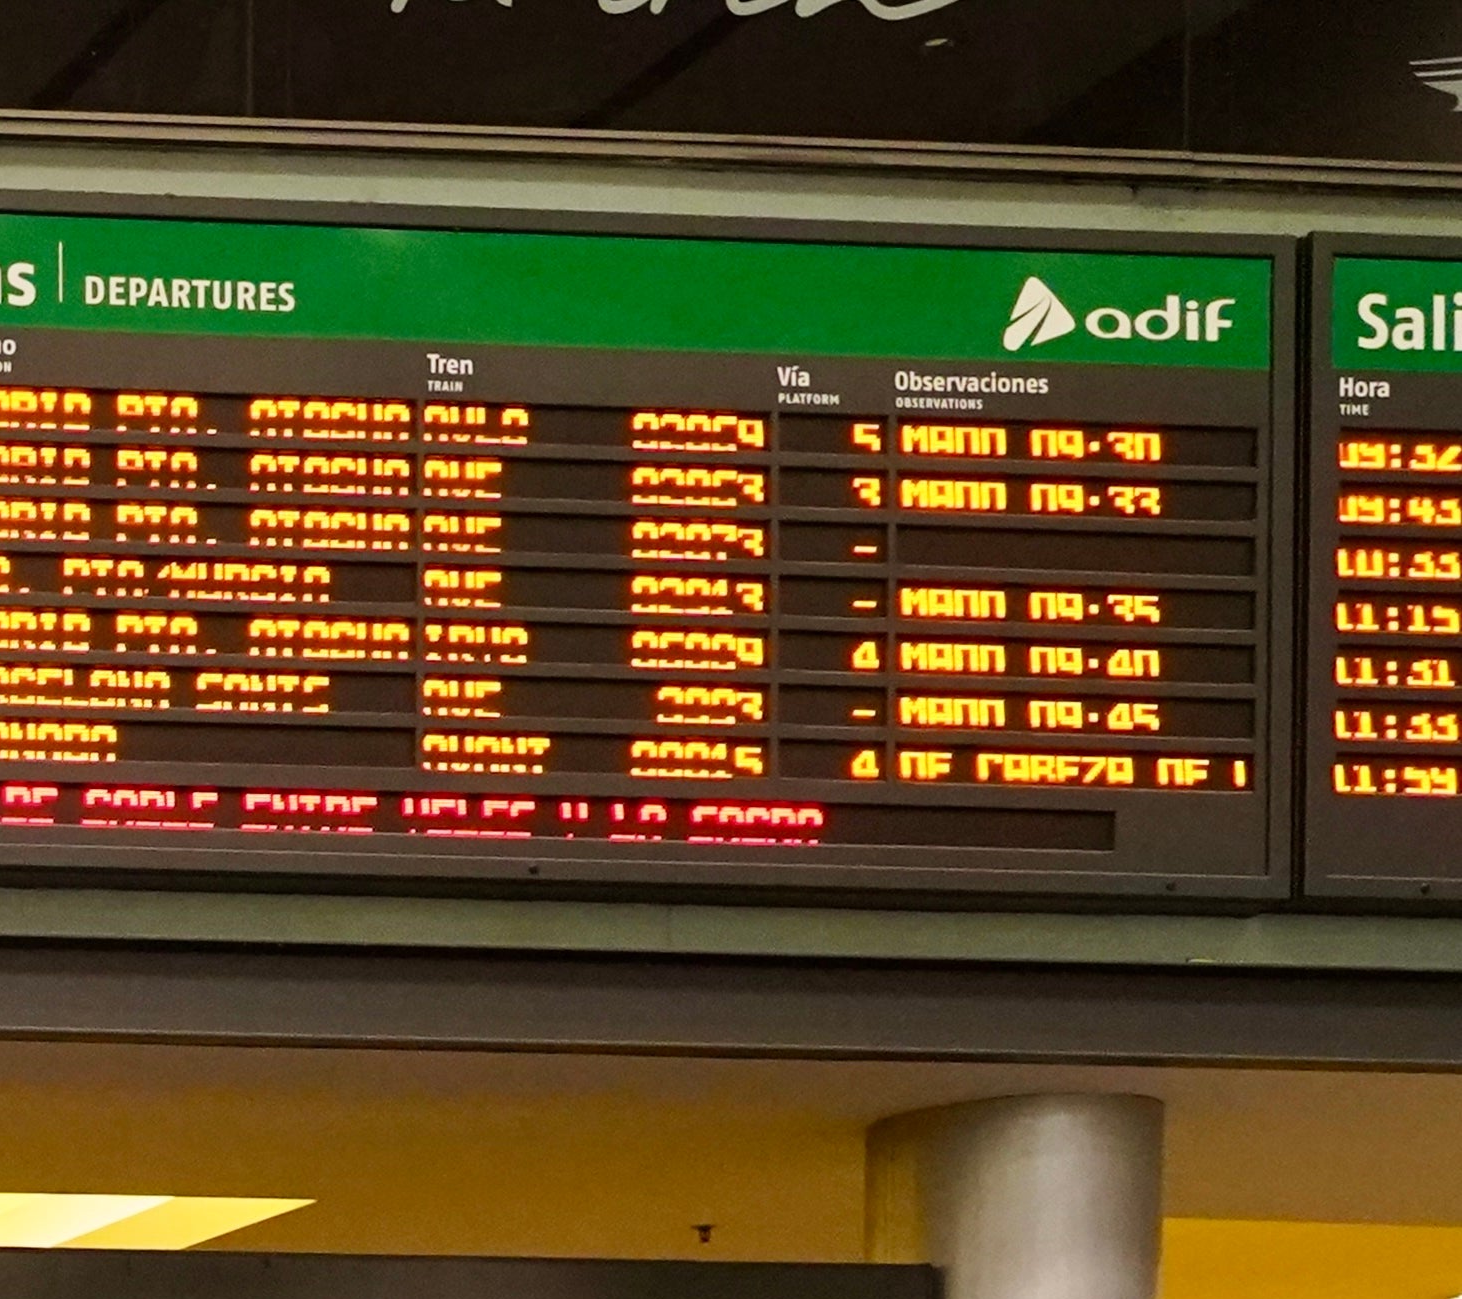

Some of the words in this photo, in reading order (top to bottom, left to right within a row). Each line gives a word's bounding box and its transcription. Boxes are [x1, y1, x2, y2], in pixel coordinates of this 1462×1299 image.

[84, 275, 295, 312] DEPARTURES
[1085, 294, 1236, 342] adif
[427, 354, 473, 375] Tren
[427, 380, 463, 392] TRAIN
[778, 365, 810, 387] Vía
[894, 371, 1049, 395] Observaciones
[1340, 377, 1390, 398] Hora
[778, 393, 839, 405] PLATFORM
[896, 397, 983, 410] OBSERVATIONS
[1340, 404, 1369, 415] TIME
